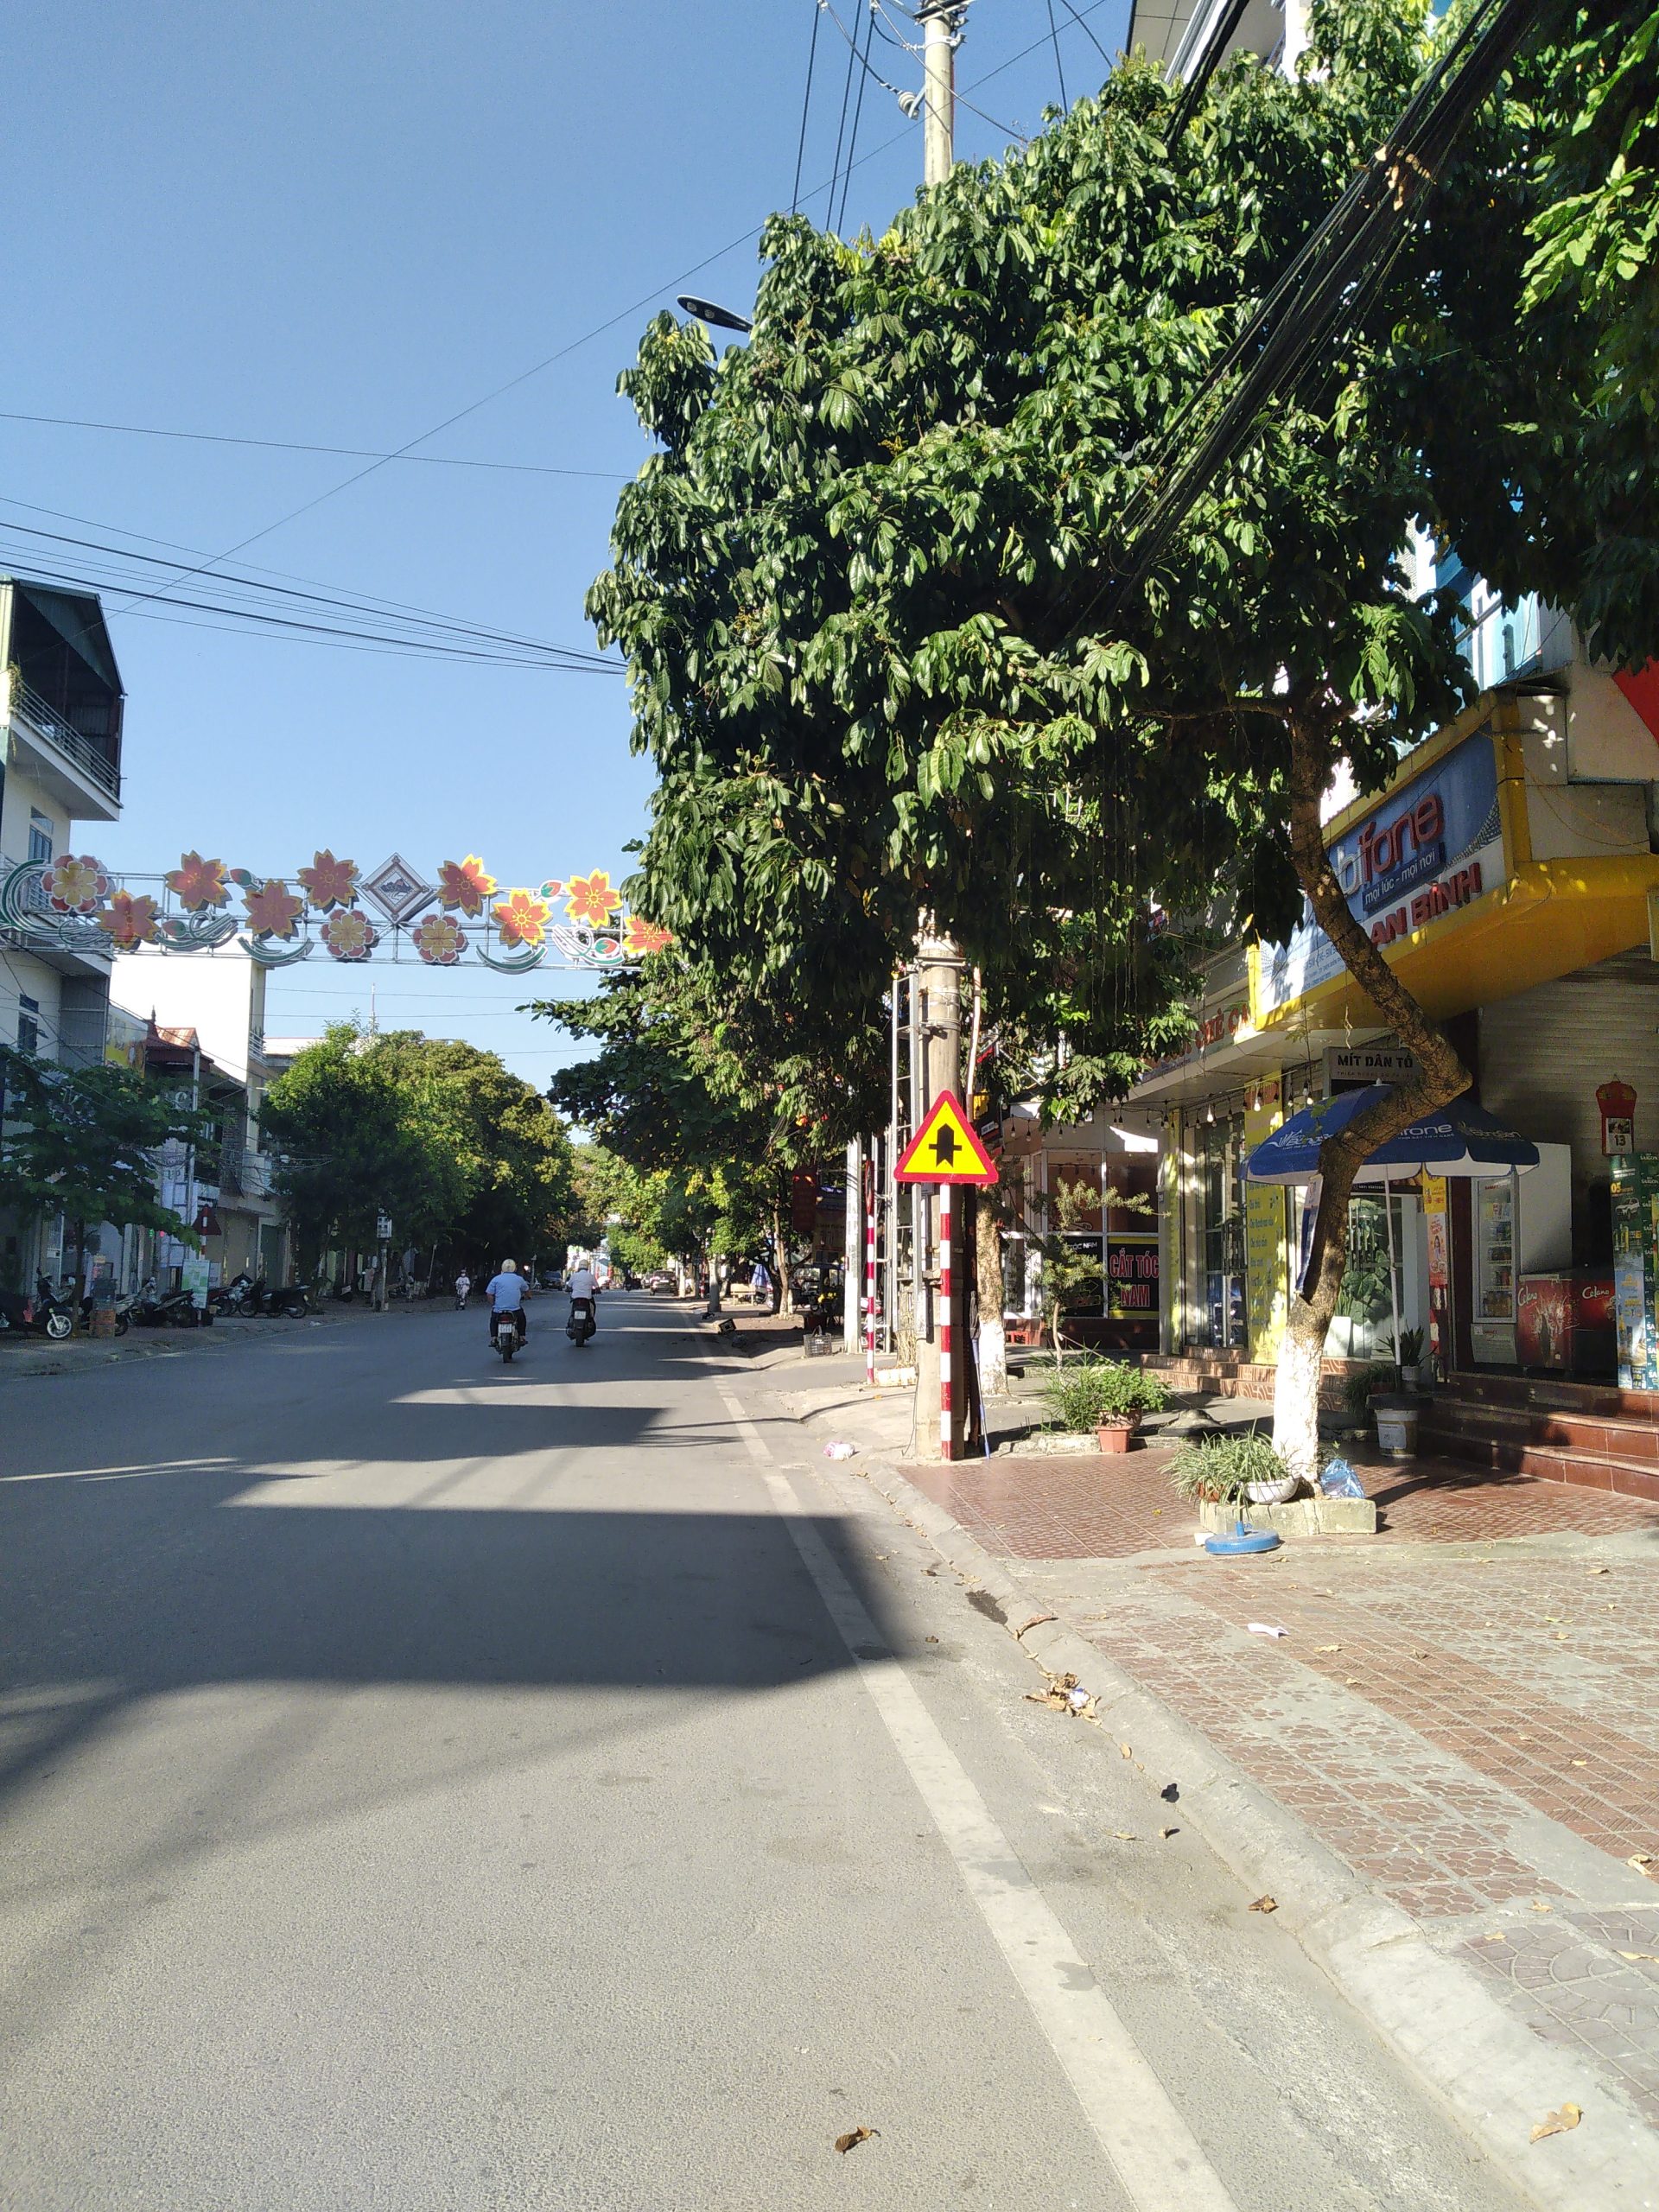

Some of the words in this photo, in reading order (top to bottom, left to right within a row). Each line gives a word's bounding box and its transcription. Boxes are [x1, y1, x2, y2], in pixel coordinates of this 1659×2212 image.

[1336, 793, 1445, 897] bifone
[1364, 884, 1380, 905] mọi
[1382, 879, 1395, 894] lúc
[1401, 864, 1418, 883] mọi
[1365, 1054, 1392, 1068] DÂN
[1614, 1135, 1626, 1147] 13
[1121, 1284, 1150, 1307] NAM
